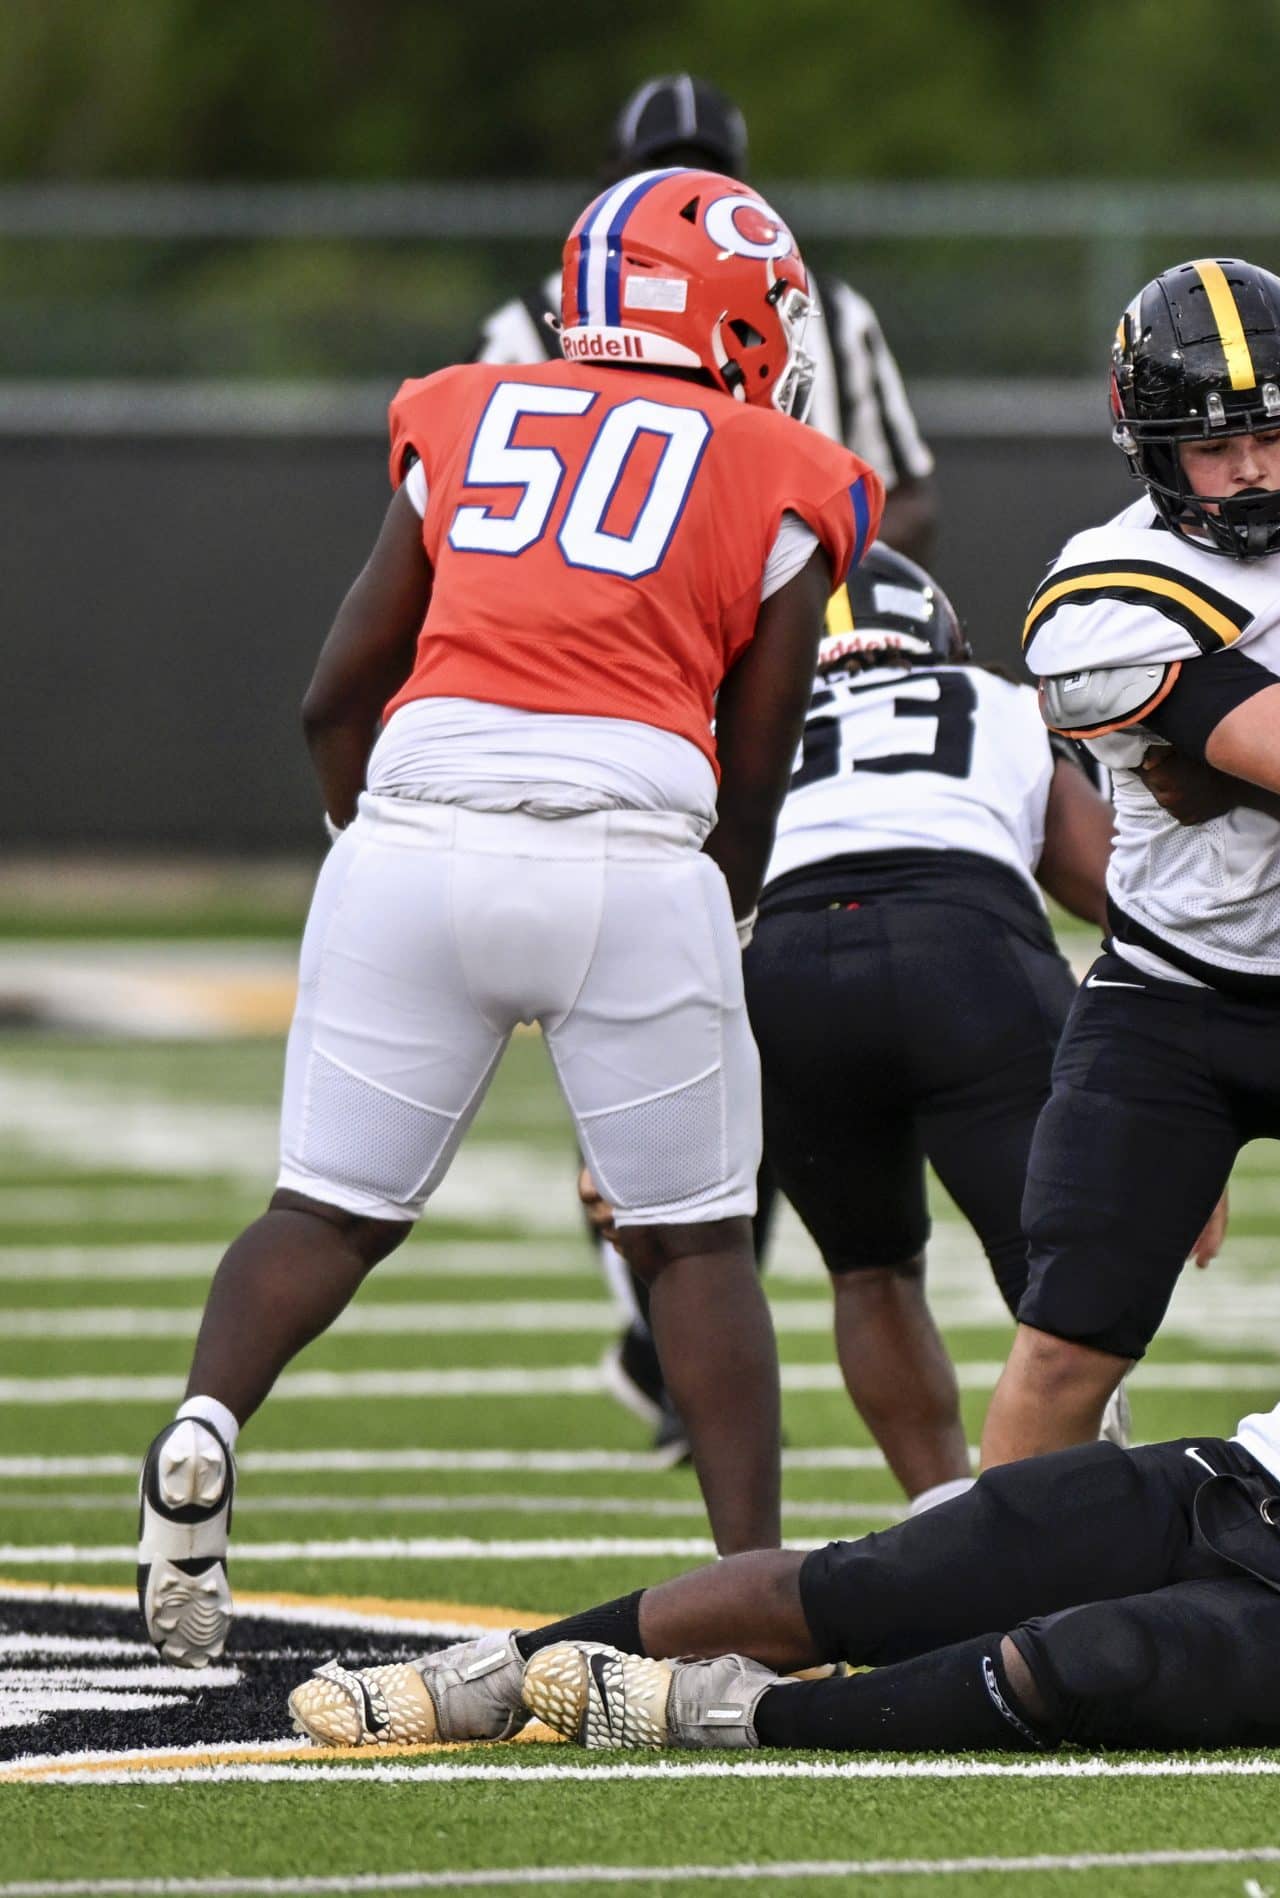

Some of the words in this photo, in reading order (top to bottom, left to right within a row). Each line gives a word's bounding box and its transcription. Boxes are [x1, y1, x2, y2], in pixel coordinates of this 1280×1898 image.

[704, 194, 793, 260] C
[563, 333, 644, 358] Riddell
[448, 381, 713, 580] 50
